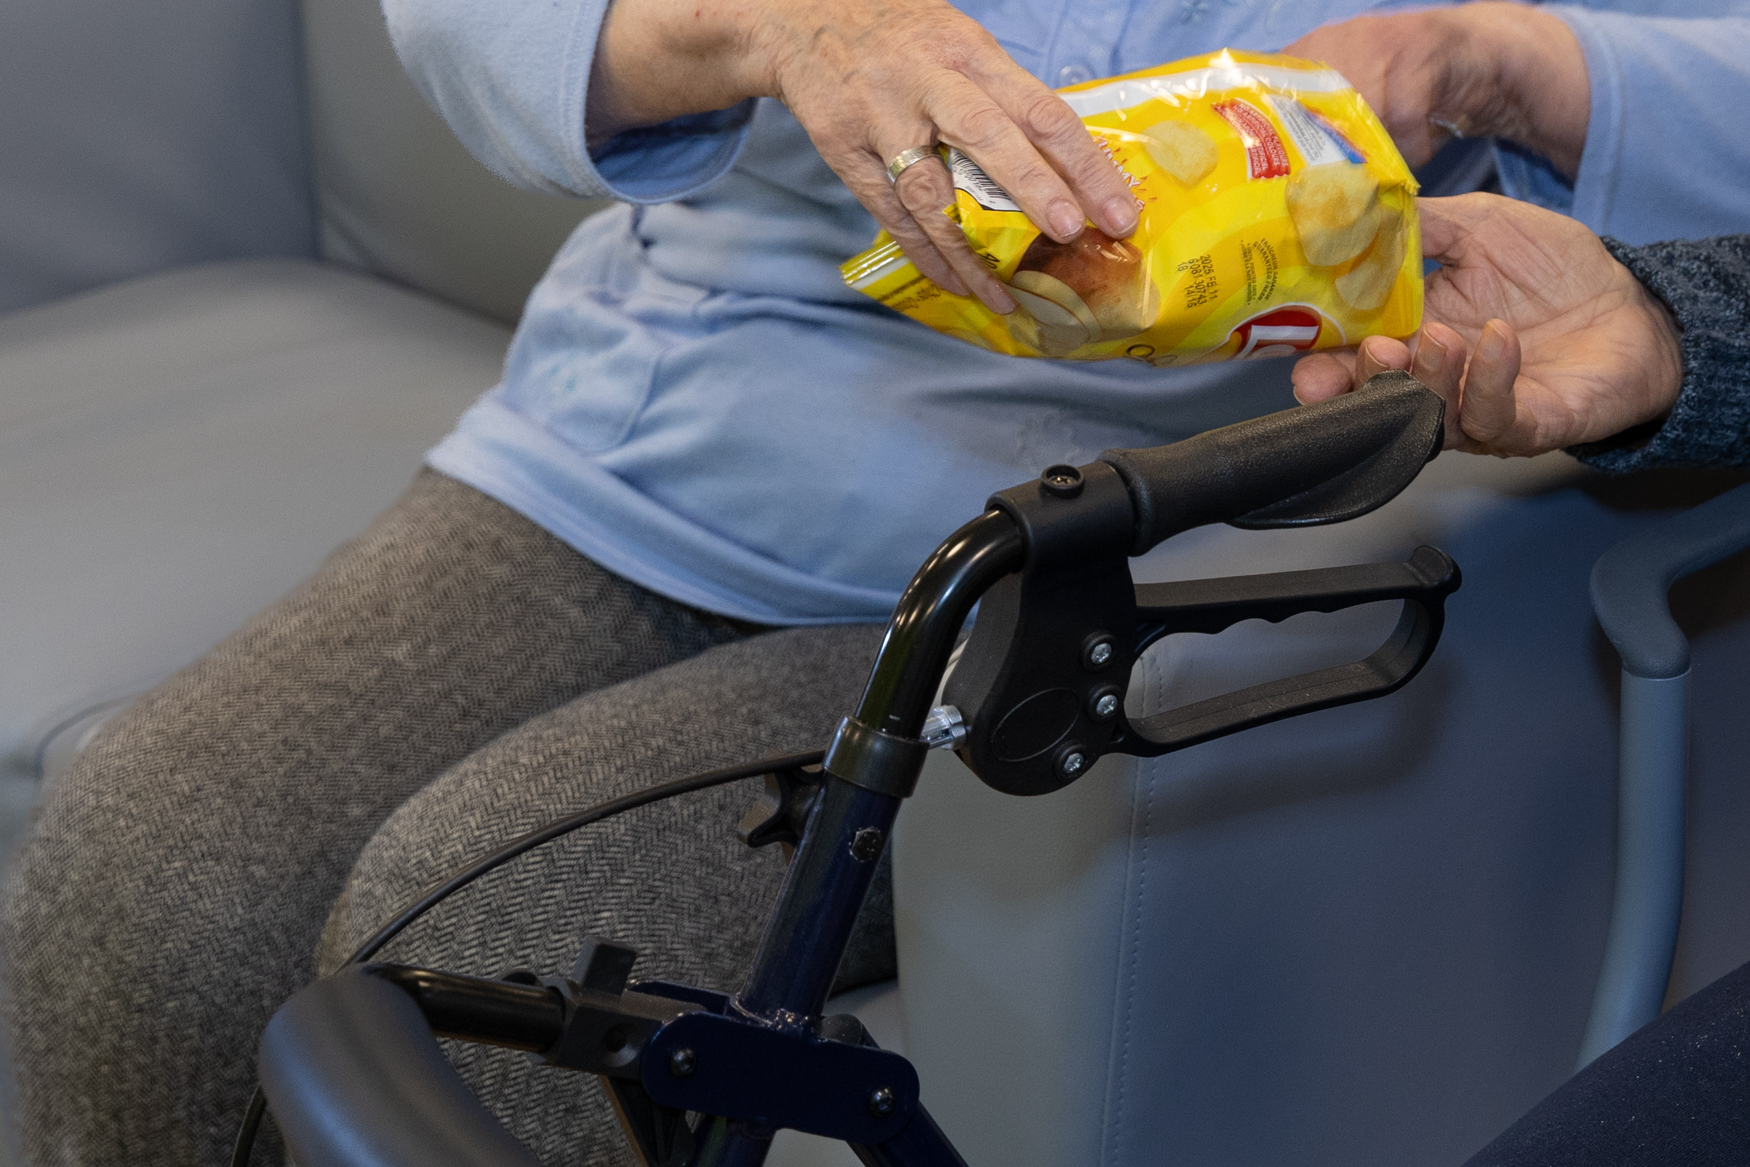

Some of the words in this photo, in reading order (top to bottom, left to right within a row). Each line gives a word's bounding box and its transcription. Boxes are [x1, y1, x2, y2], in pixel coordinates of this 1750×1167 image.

[1241, 111, 1268, 137] ARTIFICIAL
[1265, 135, 1280, 166] COLOURS
[1271, 134, 1288, 167] FLAVOURS
[1199, 253, 1214, 275] 2025
[1193, 278, 1207, 305] 30743
[1204, 274, 1217, 288] FE
[1208, 289, 1218, 299] 11
